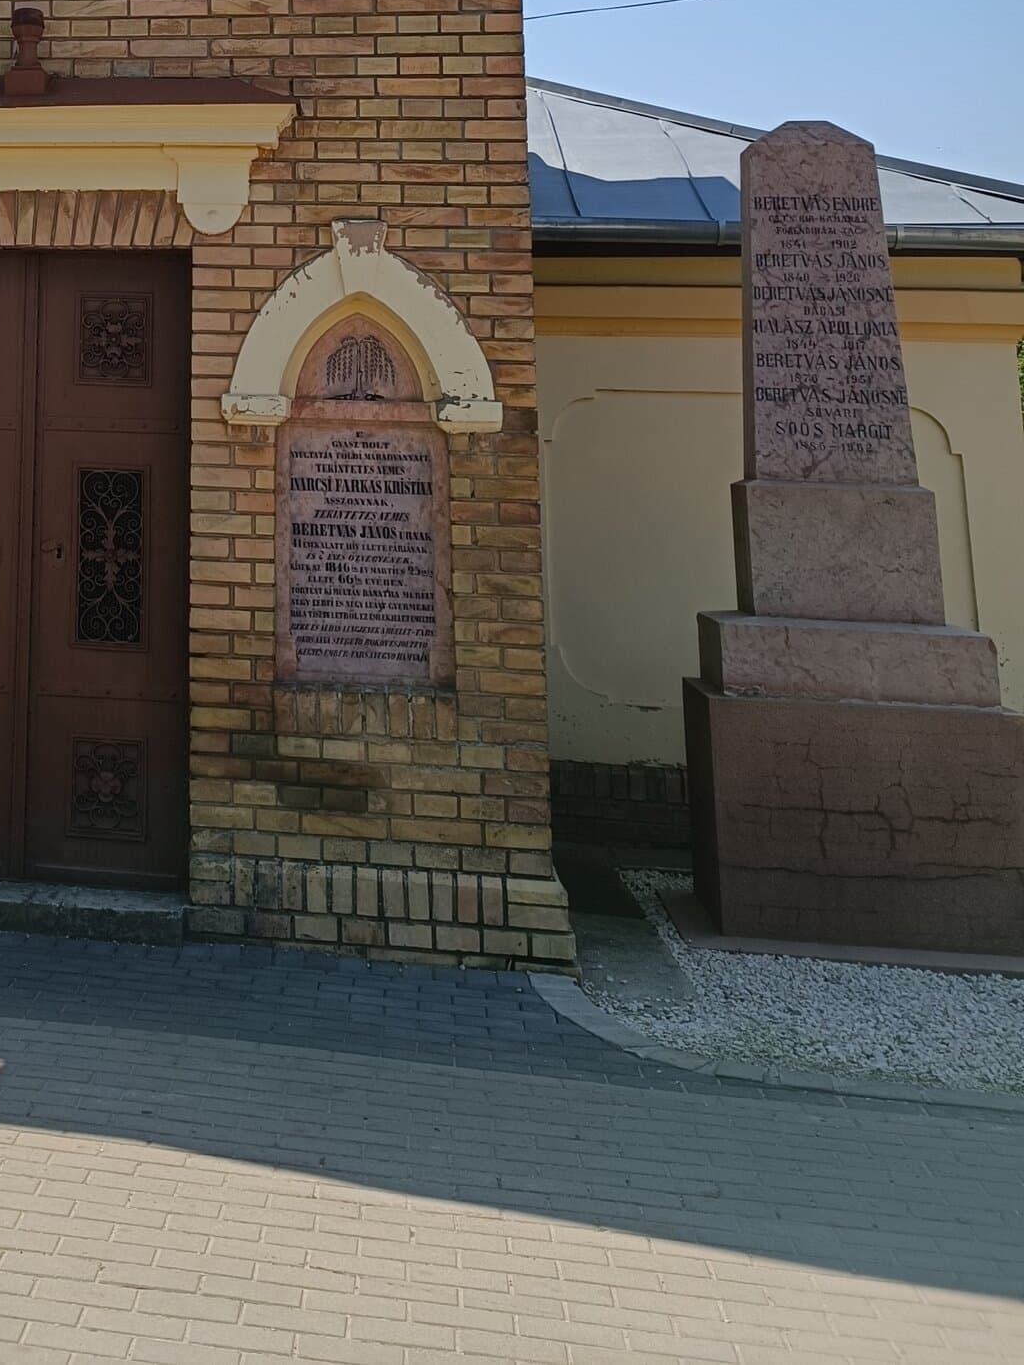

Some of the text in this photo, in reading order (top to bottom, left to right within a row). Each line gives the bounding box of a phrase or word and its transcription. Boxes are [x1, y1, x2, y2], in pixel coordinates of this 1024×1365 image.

[754, 194, 880, 212] BERETVÁS ENDRE
[831, 240, 857, 250] 1902
[756, 252, 886, 268] BERETVÁS JÁNOS
[754, 284, 894, 302] BERETVÁS JÁNOSNÉ
[754, 316, 814, 334] HALÁSZ
[756, 350, 900, 371] BERETVÁS JÁNOS
[756, 385, 908, 405] BERETVÁS JÁNOSNÉ
[336, 478, 382, 494] FARKAS
[292, 520, 356, 538] BERETVÁS
[360, 522, 397, 540] JÁNOS
